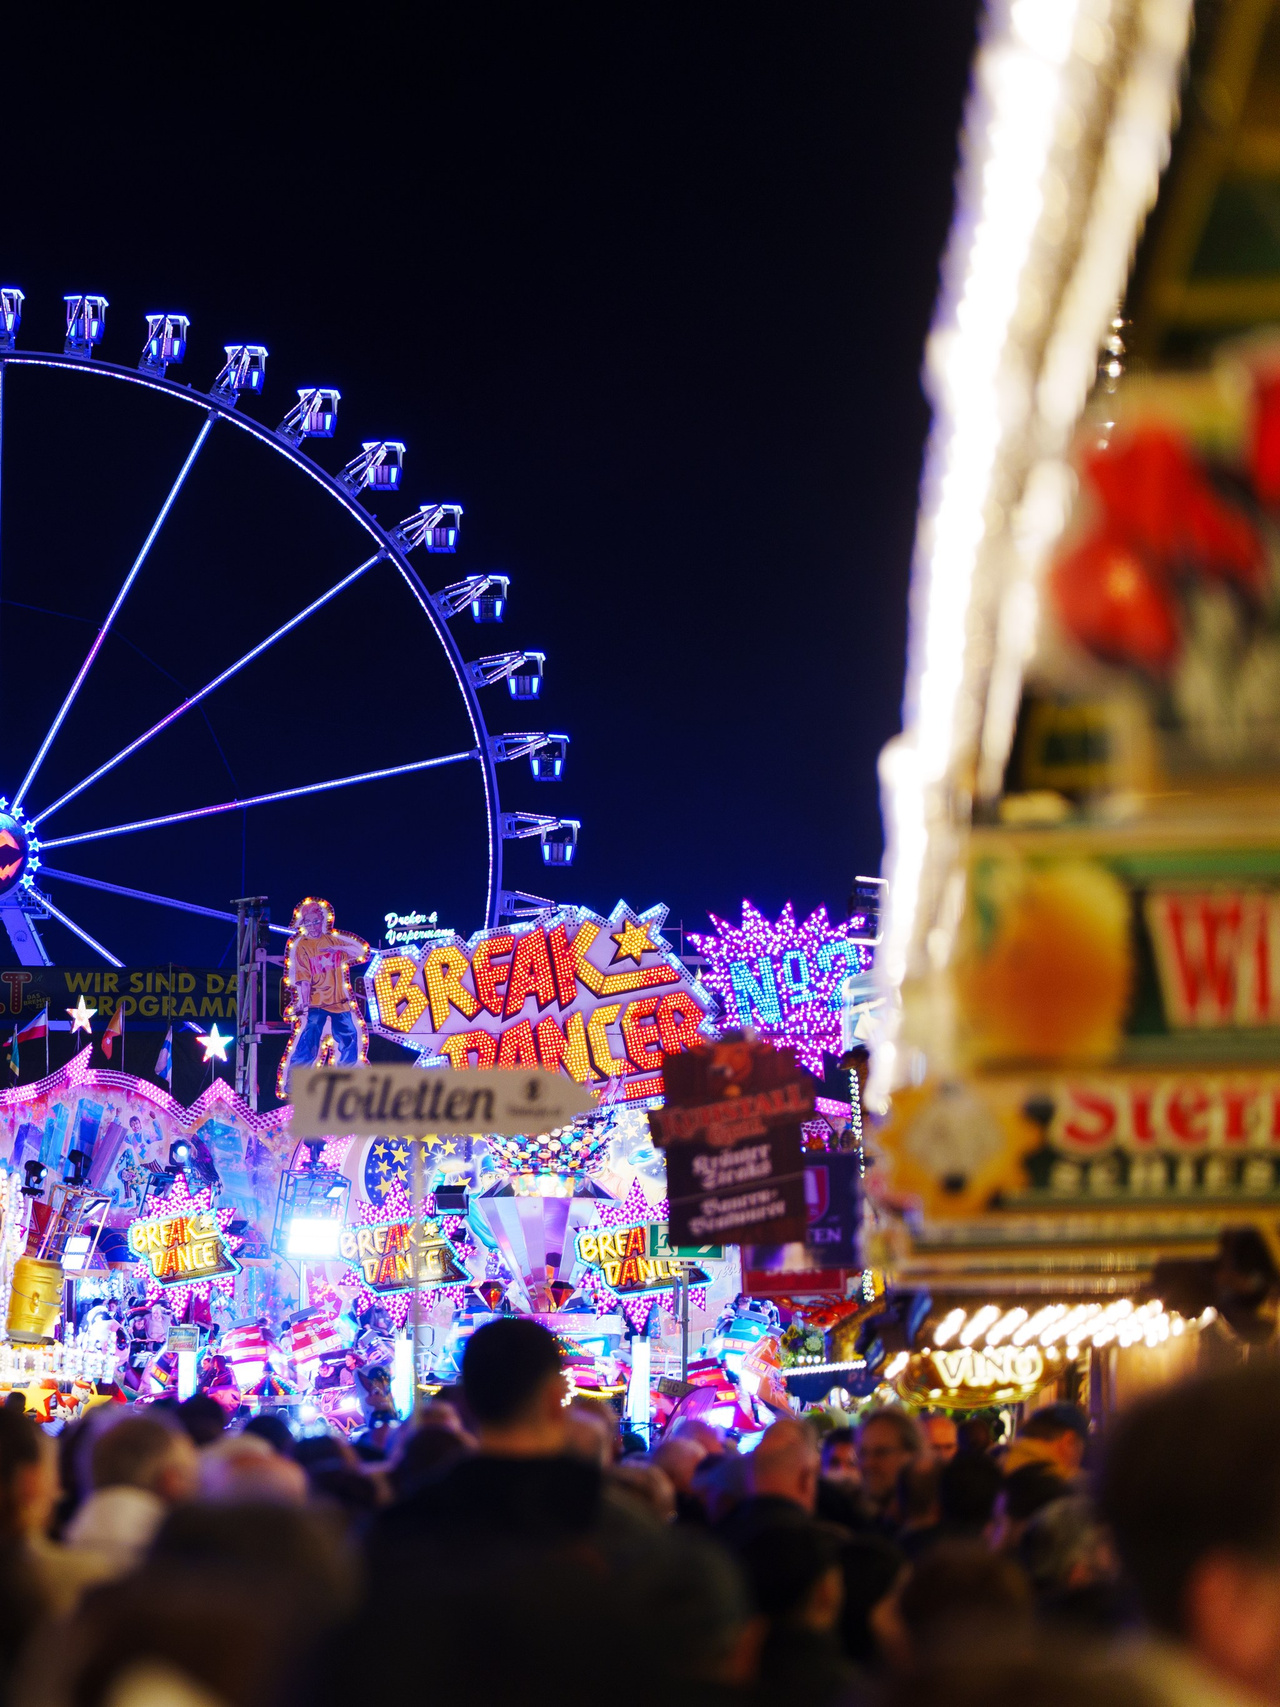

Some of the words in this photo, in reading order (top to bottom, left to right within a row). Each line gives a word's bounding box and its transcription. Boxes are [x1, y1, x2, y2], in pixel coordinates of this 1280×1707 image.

[64, 972, 119, 994] WIR
[130, 972, 196, 994] SIND
[373, 919, 681, 1034] BREAK
[306, 1071, 496, 1123] Toiletten
[132, 1215, 219, 1252] BREAK
[340, 1222, 445, 1259] BREAK
[579, 1226, 647, 1262] BREA
[932, 1347, 1045, 1388] VINO
